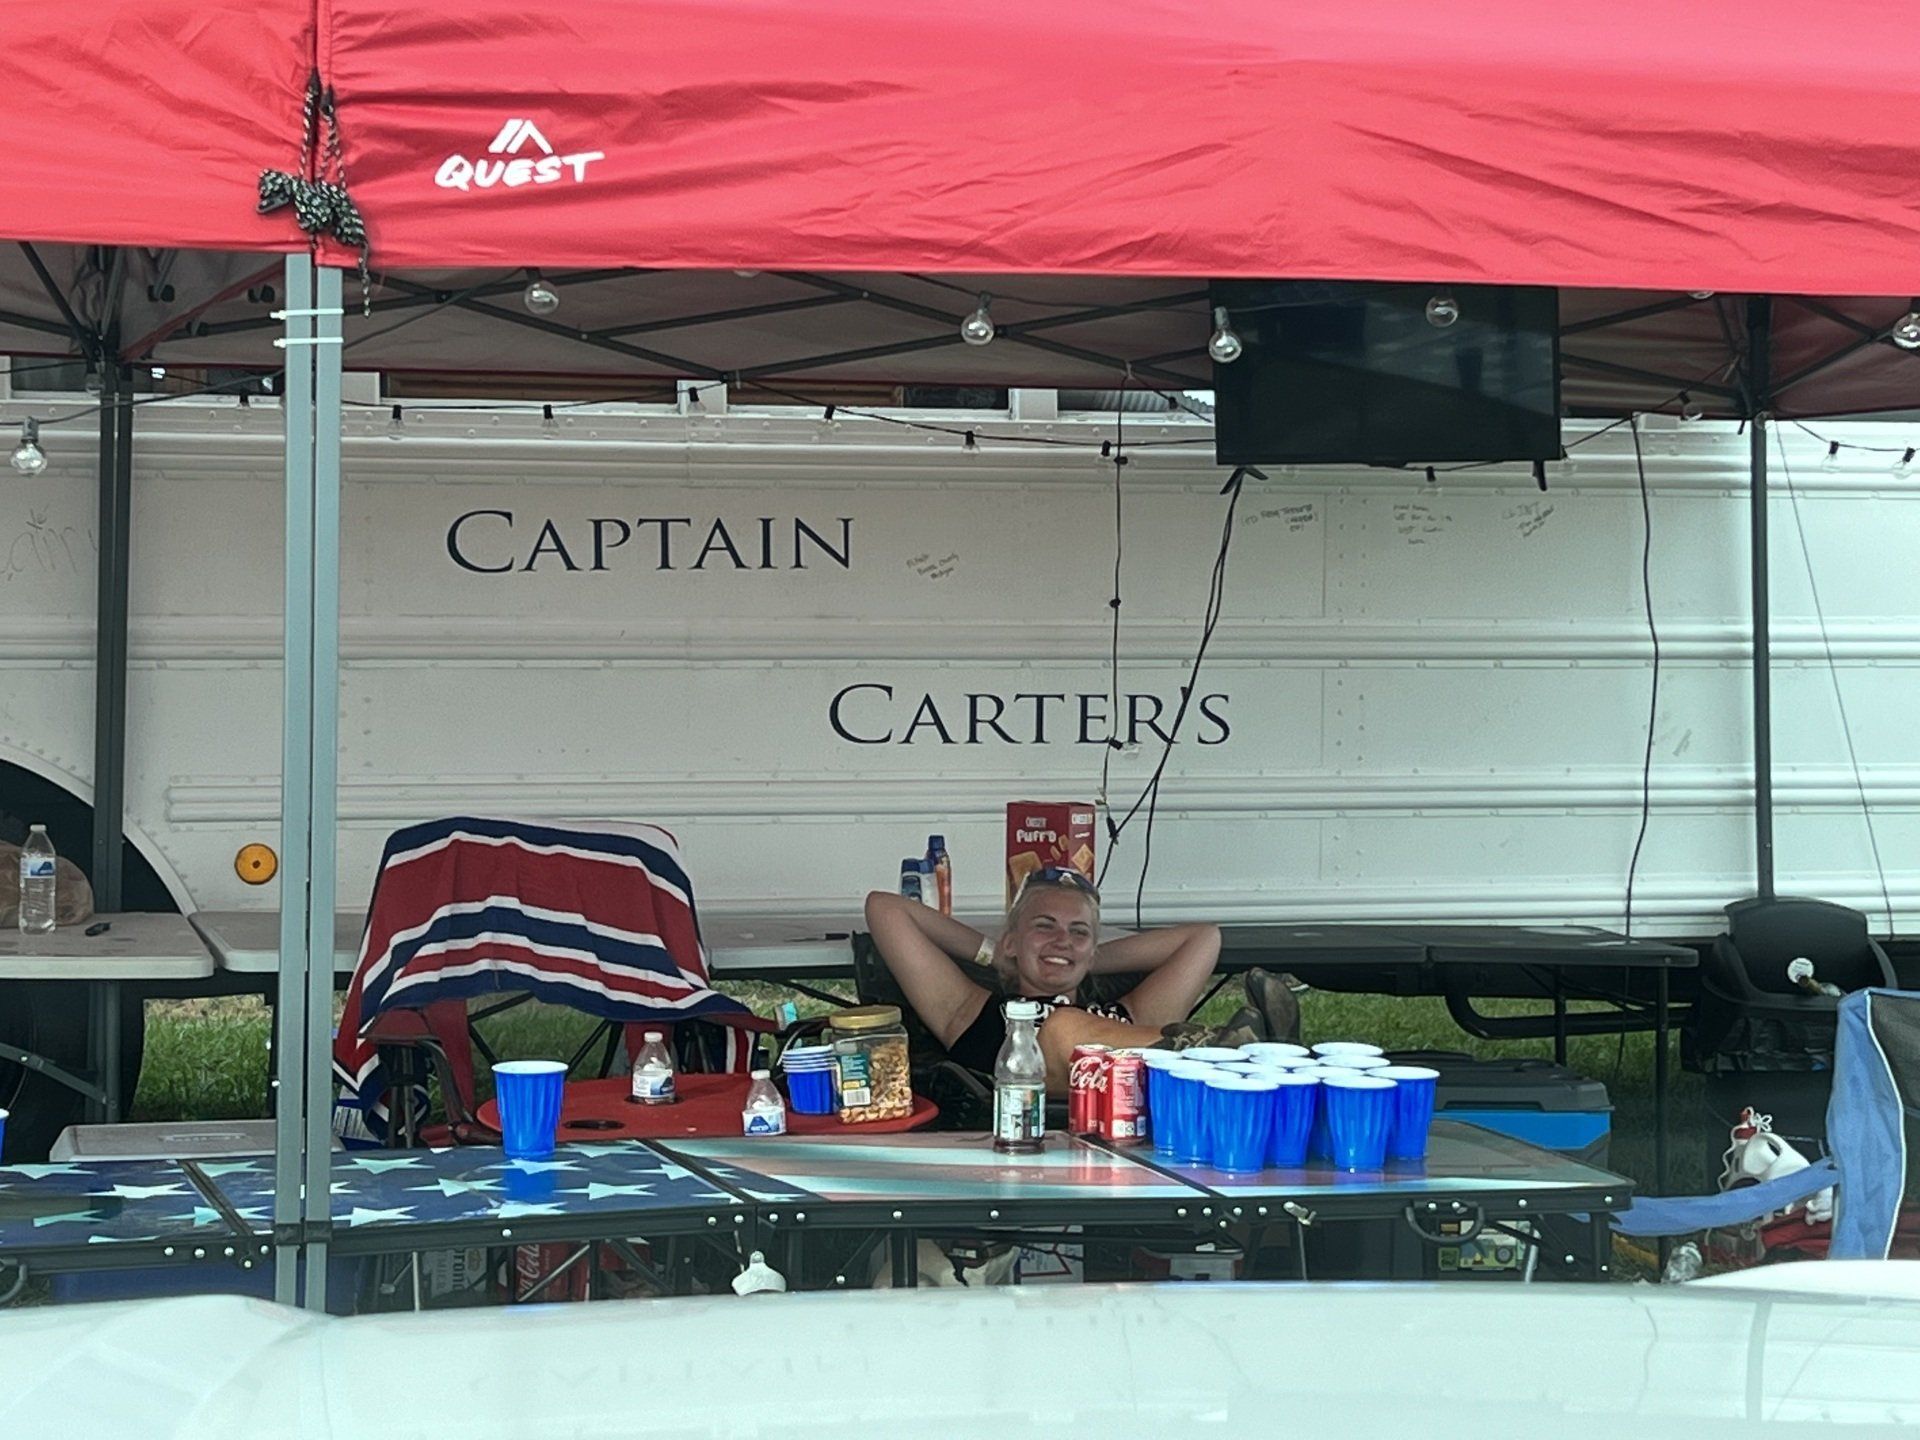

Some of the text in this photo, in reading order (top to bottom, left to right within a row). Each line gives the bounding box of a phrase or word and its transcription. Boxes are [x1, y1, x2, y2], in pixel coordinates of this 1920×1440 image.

[434, 151, 605, 192] QUEST
[446, 509, 855, 574] CAPTAIN
[829, 684, 1231, 745] CARTER'S
